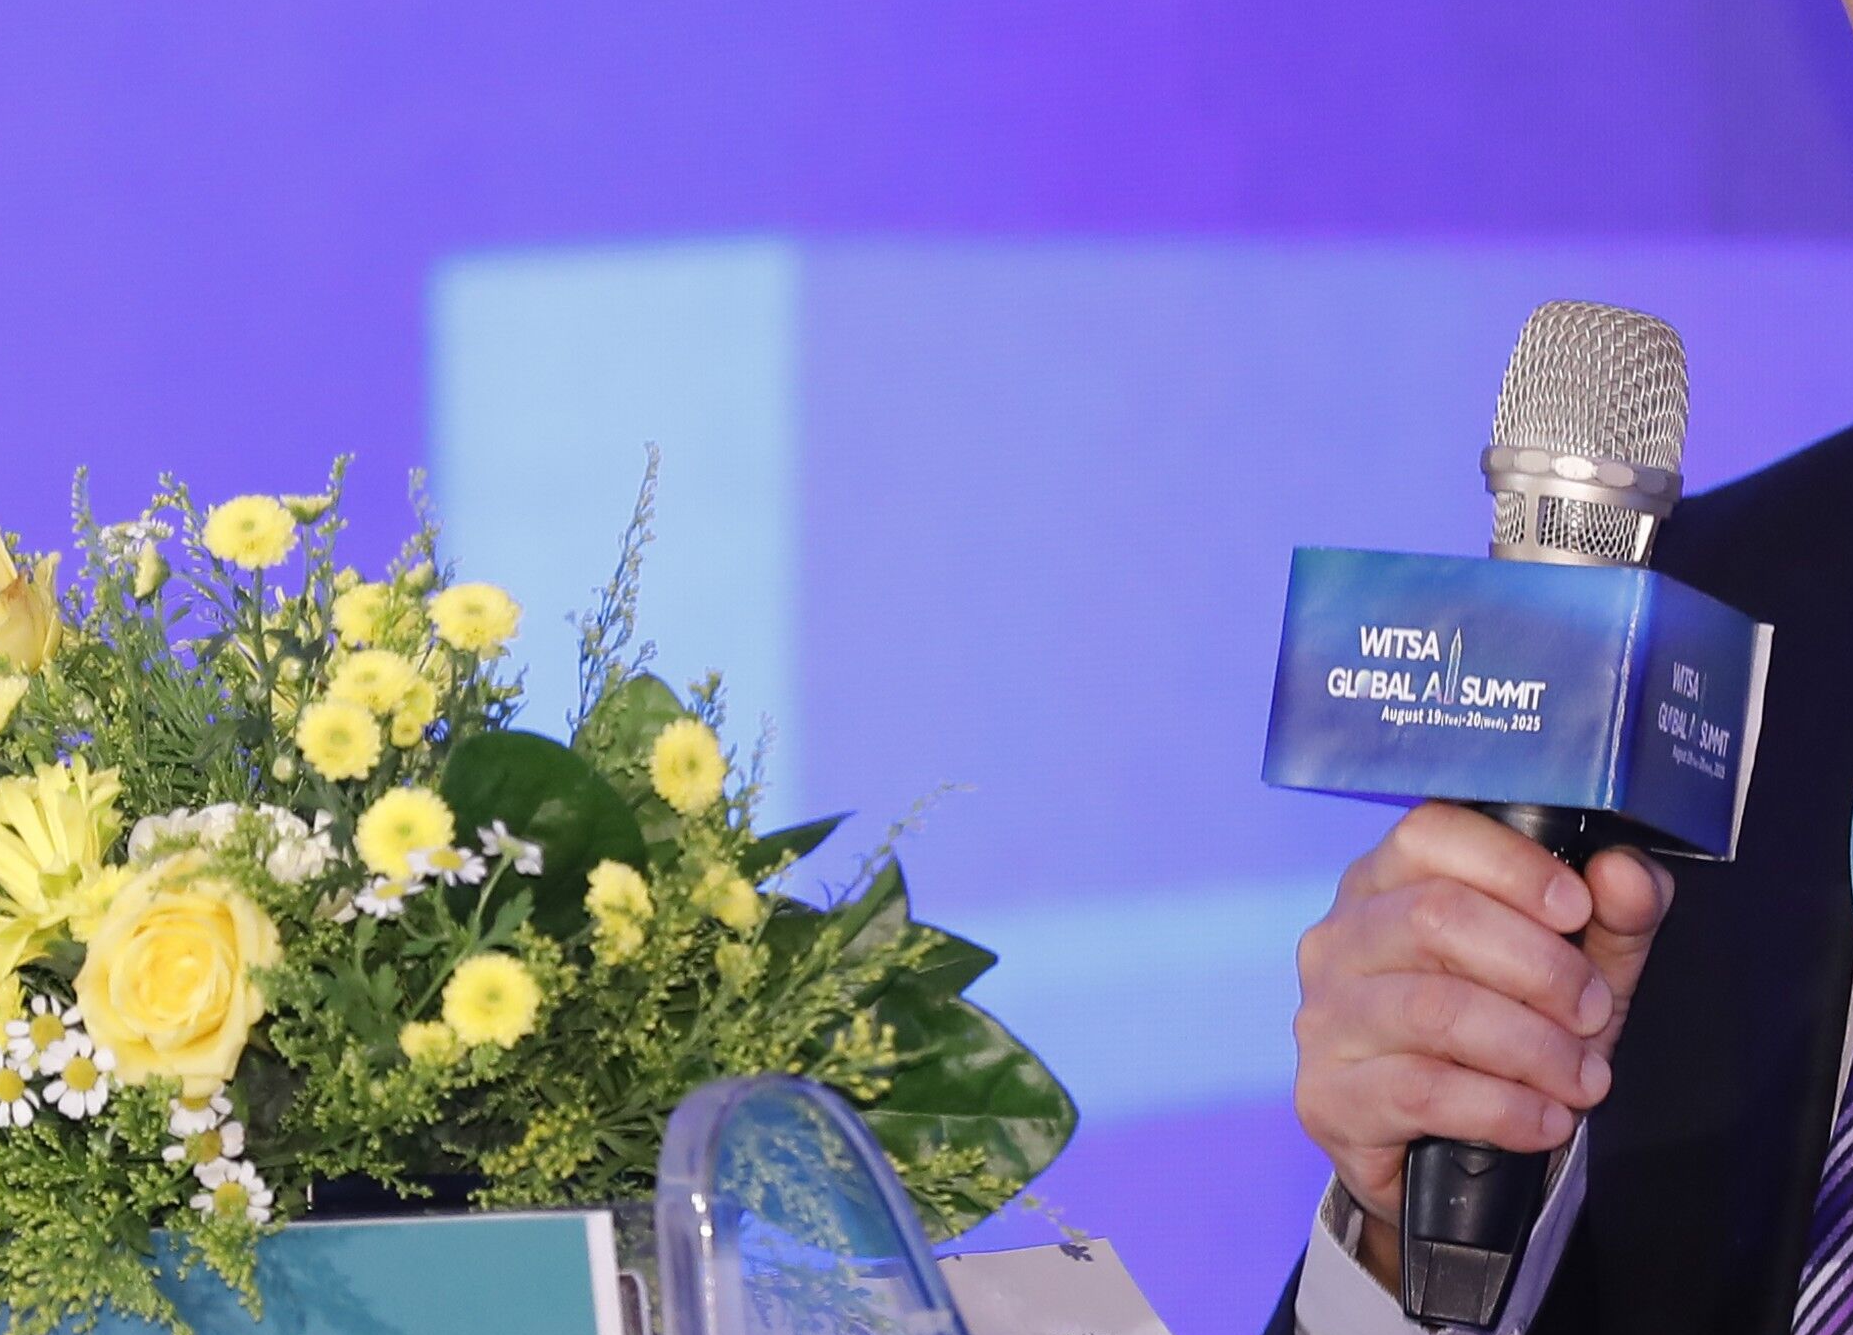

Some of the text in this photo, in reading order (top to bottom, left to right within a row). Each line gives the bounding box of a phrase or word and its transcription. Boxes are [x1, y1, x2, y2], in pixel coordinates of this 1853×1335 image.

[1360, 625, 1441, 661] WITSA
[1327, 666, 1417, 703] GLOBAL
[1460, 674, 1546, 711] SUMMIT
[1381, 705, 1424, 727] August
[1511, 714, 1541, 732] 2025
